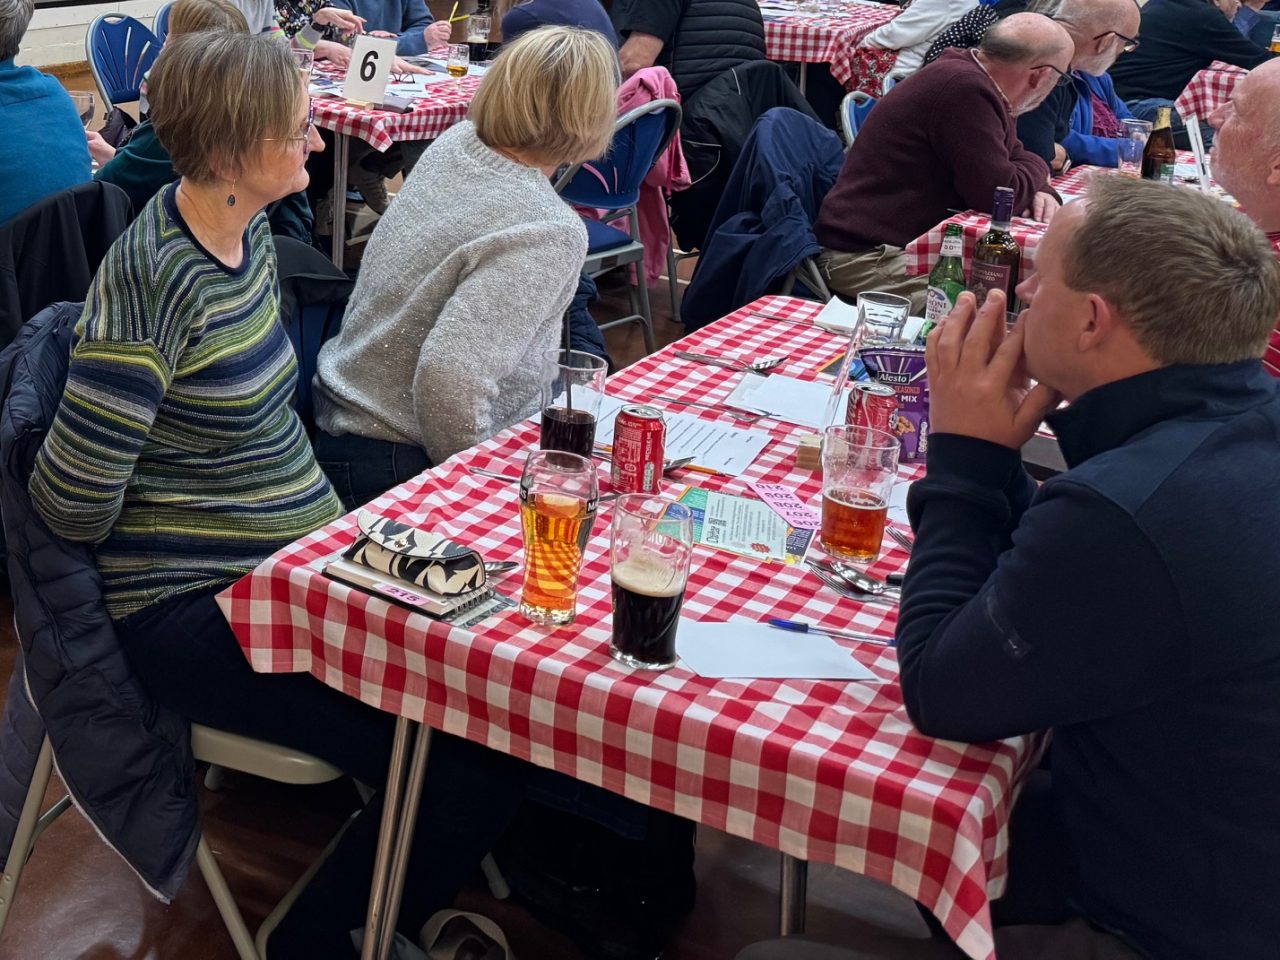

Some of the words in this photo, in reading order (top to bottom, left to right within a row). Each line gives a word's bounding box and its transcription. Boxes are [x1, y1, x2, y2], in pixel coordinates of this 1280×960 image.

[360, 50, 379, 82] 6
[879, 373, 908, 383] Alesto
[901, 395, 918, 403] MIX
